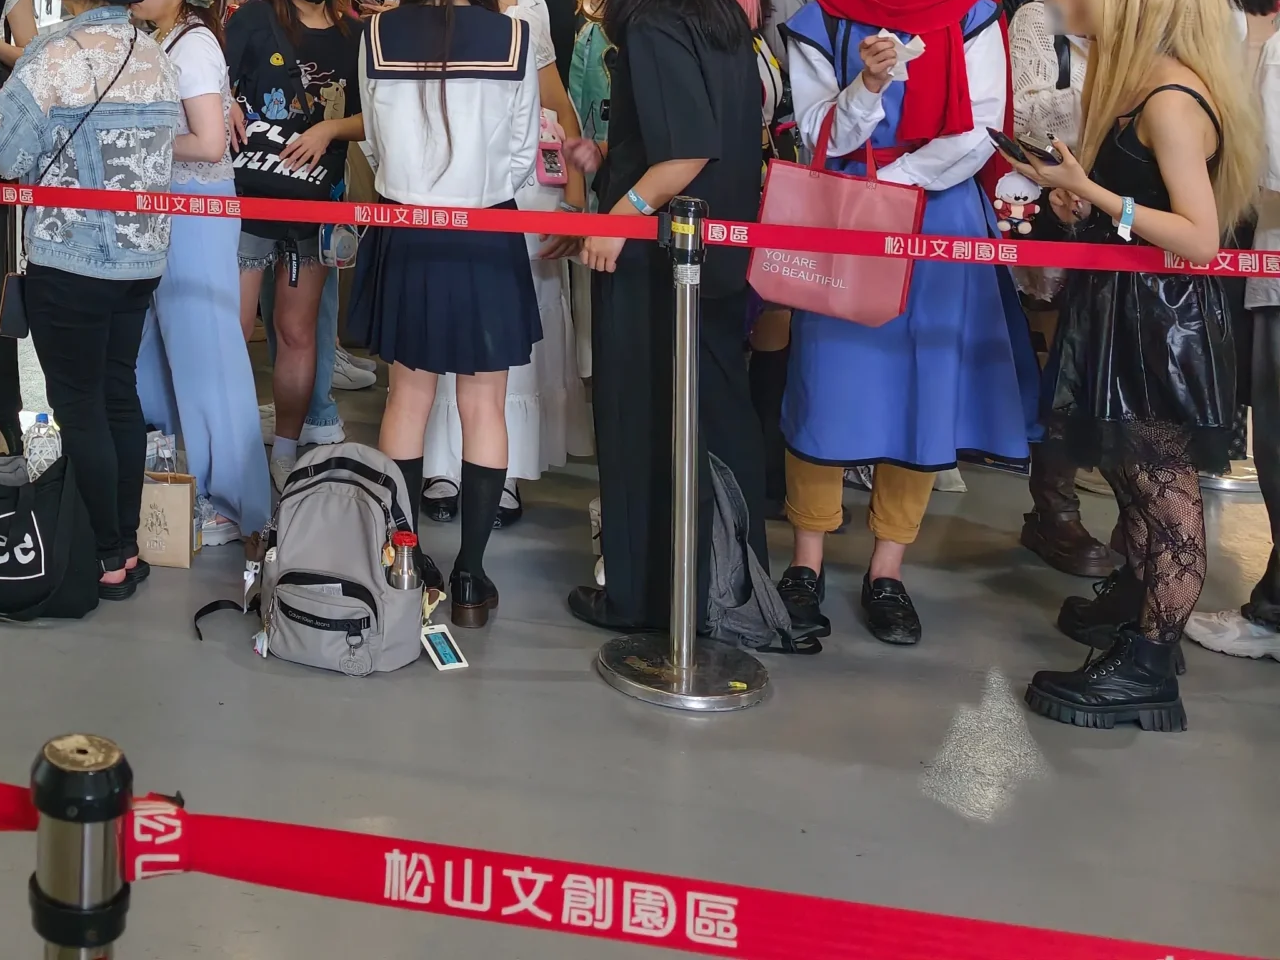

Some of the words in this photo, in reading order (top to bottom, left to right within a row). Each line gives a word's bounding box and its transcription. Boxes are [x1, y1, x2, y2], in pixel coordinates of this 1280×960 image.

[136, 193, 241, 216] 松山文創園區
[354, 205, 468, 228] 松山文創園區
[708, 223, 748, 244] 園區
[765, 249, 791, 264] YOU
[792, 257, 817, 270] ARE
[884, 235, 1017, 263] 松山文創園區
[762, 262, 779, 274] SO
[782, 267, 849, 289] BEAUTIFUL.
[302, 616, 314, 624] Klein
[314, 620, 330, 628] Jeans
[384, 849, 738, 948] 松山文創園區
